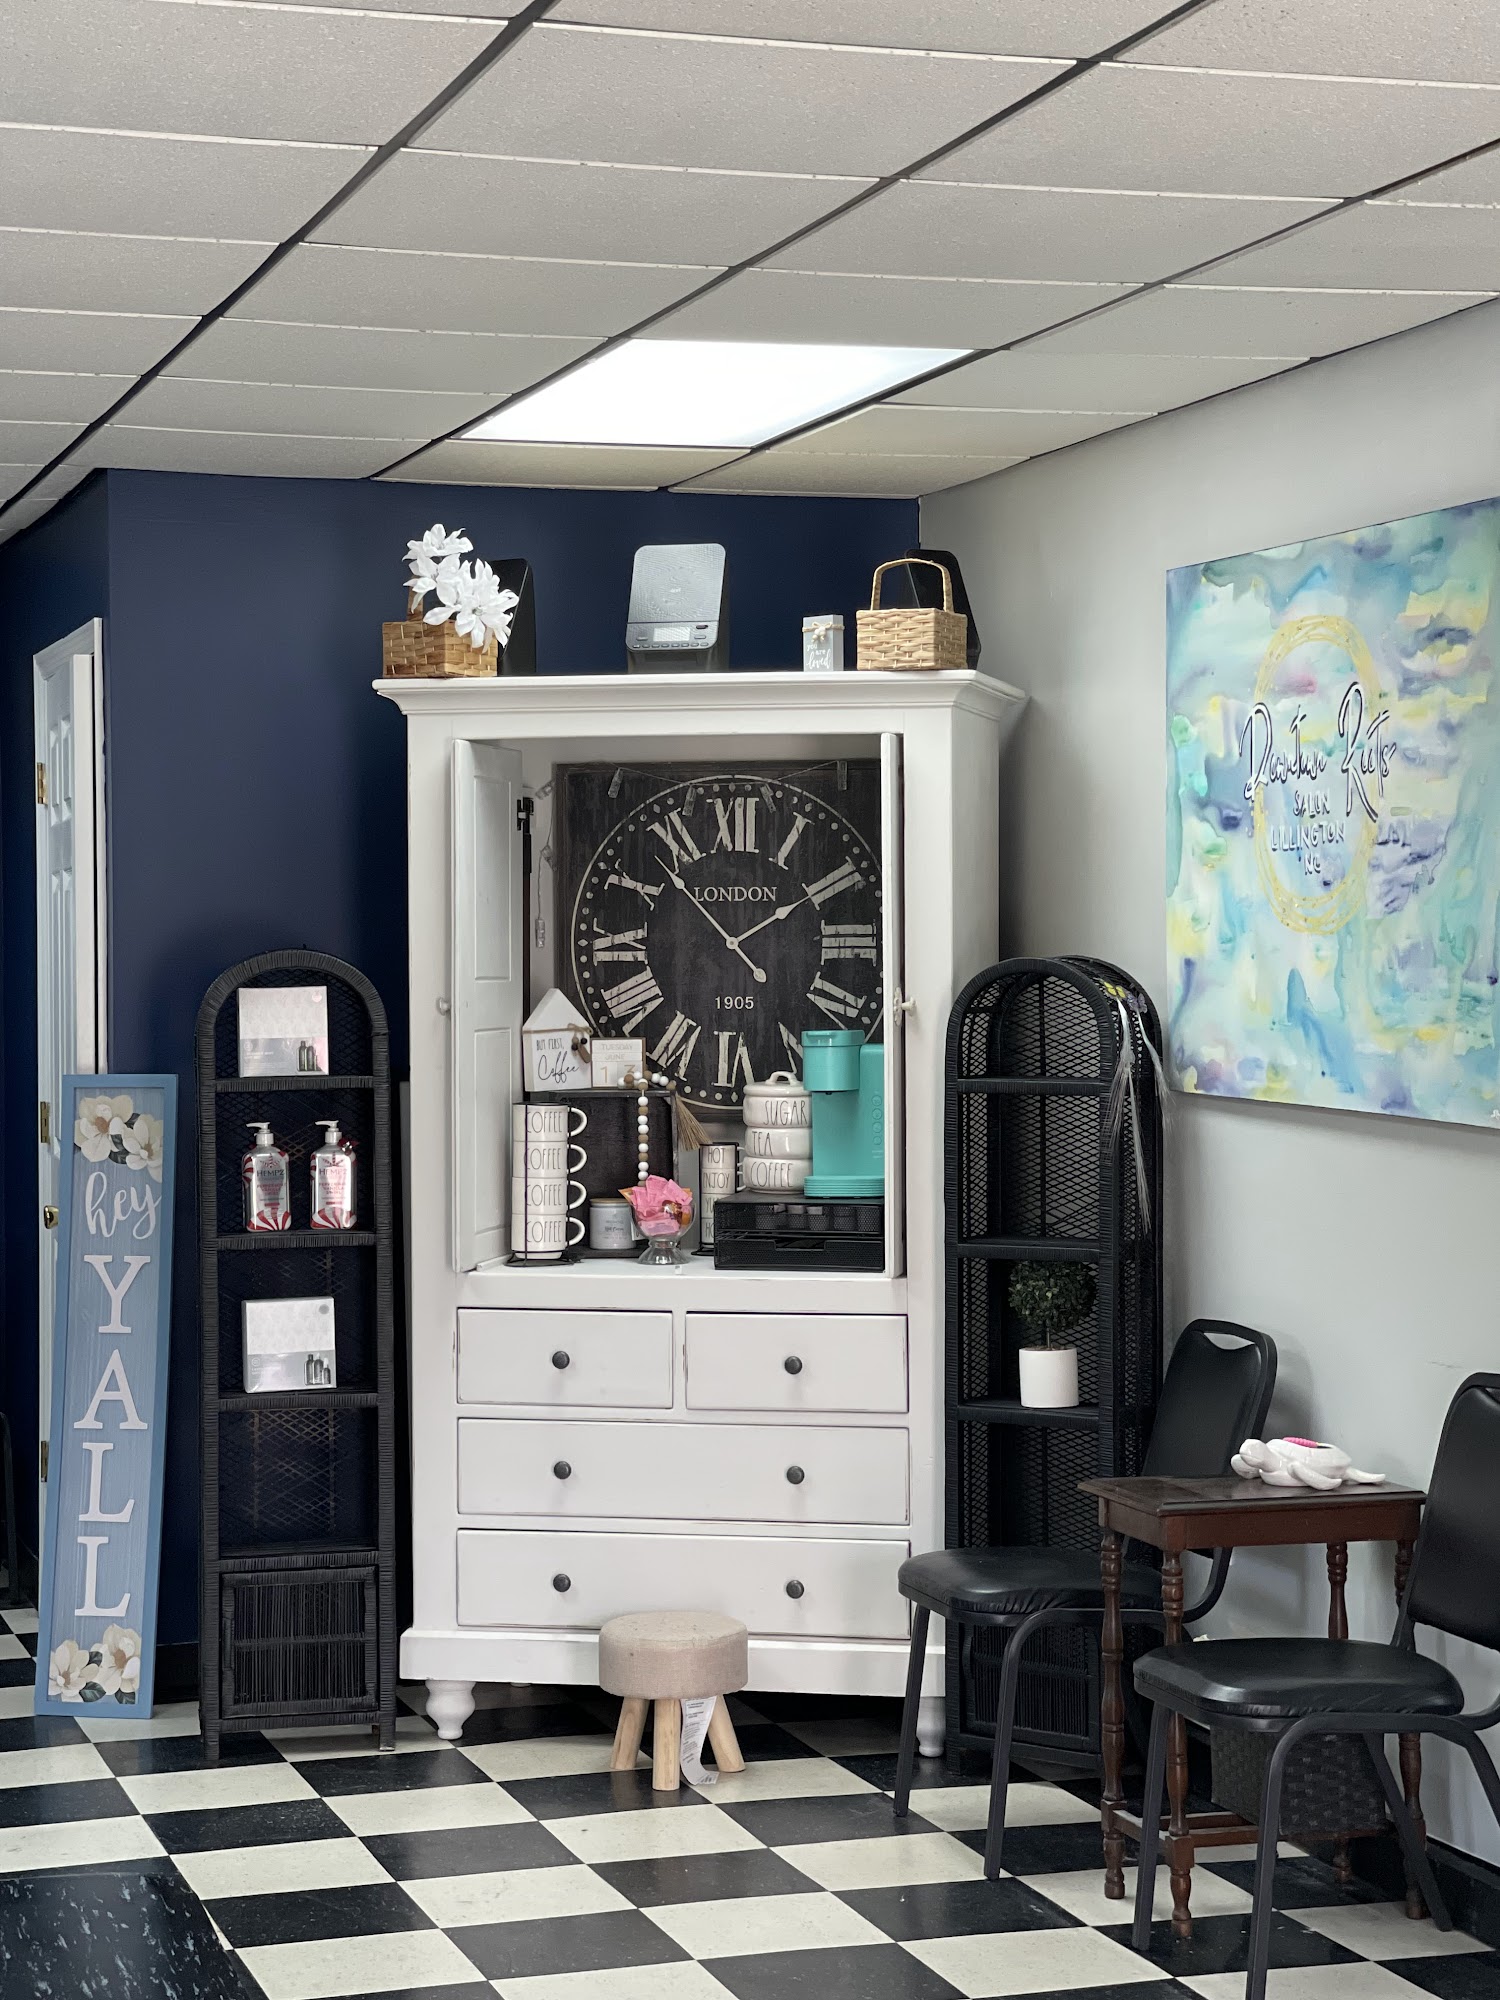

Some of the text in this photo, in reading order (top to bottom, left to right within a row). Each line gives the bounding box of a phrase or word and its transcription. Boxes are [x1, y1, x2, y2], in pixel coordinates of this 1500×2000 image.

[806, 648, 832, 670] loved
[1338, 681, 1397, 823] Roots
[1293, 789, 1331, 819] SALON
[706, 797, 760, 854] XII
[1270, 820, 1346, 852] LILLINGTON
[645, 807, 707, 875] XI
[1304, 854, 1321, 875] NC
[694, 886, 778, 903] LONDON
[819, 919, 877, 967] III
[714, 996, 755, 1010] 1905
[601, 1043, 634, 1051] TUESDAY
[605, 1053, 625, 1061] JUNE
[538, 1051, 580, 1084] Coffee
[763, 1100, 808, 1126] SUGAR
[707, 1147, 726, 1164] HOT
[752, 1131, 774, 1157] TEA
[257, 1169, 285, 1177] HEMPZ
[319, 1168, 347, 1176] HEMPZ
[702, 1172, 730, 1189] ENJOY
[750, 1161, 794, 1188] COFFEE
[84, 1171, 163, 1240] hey
